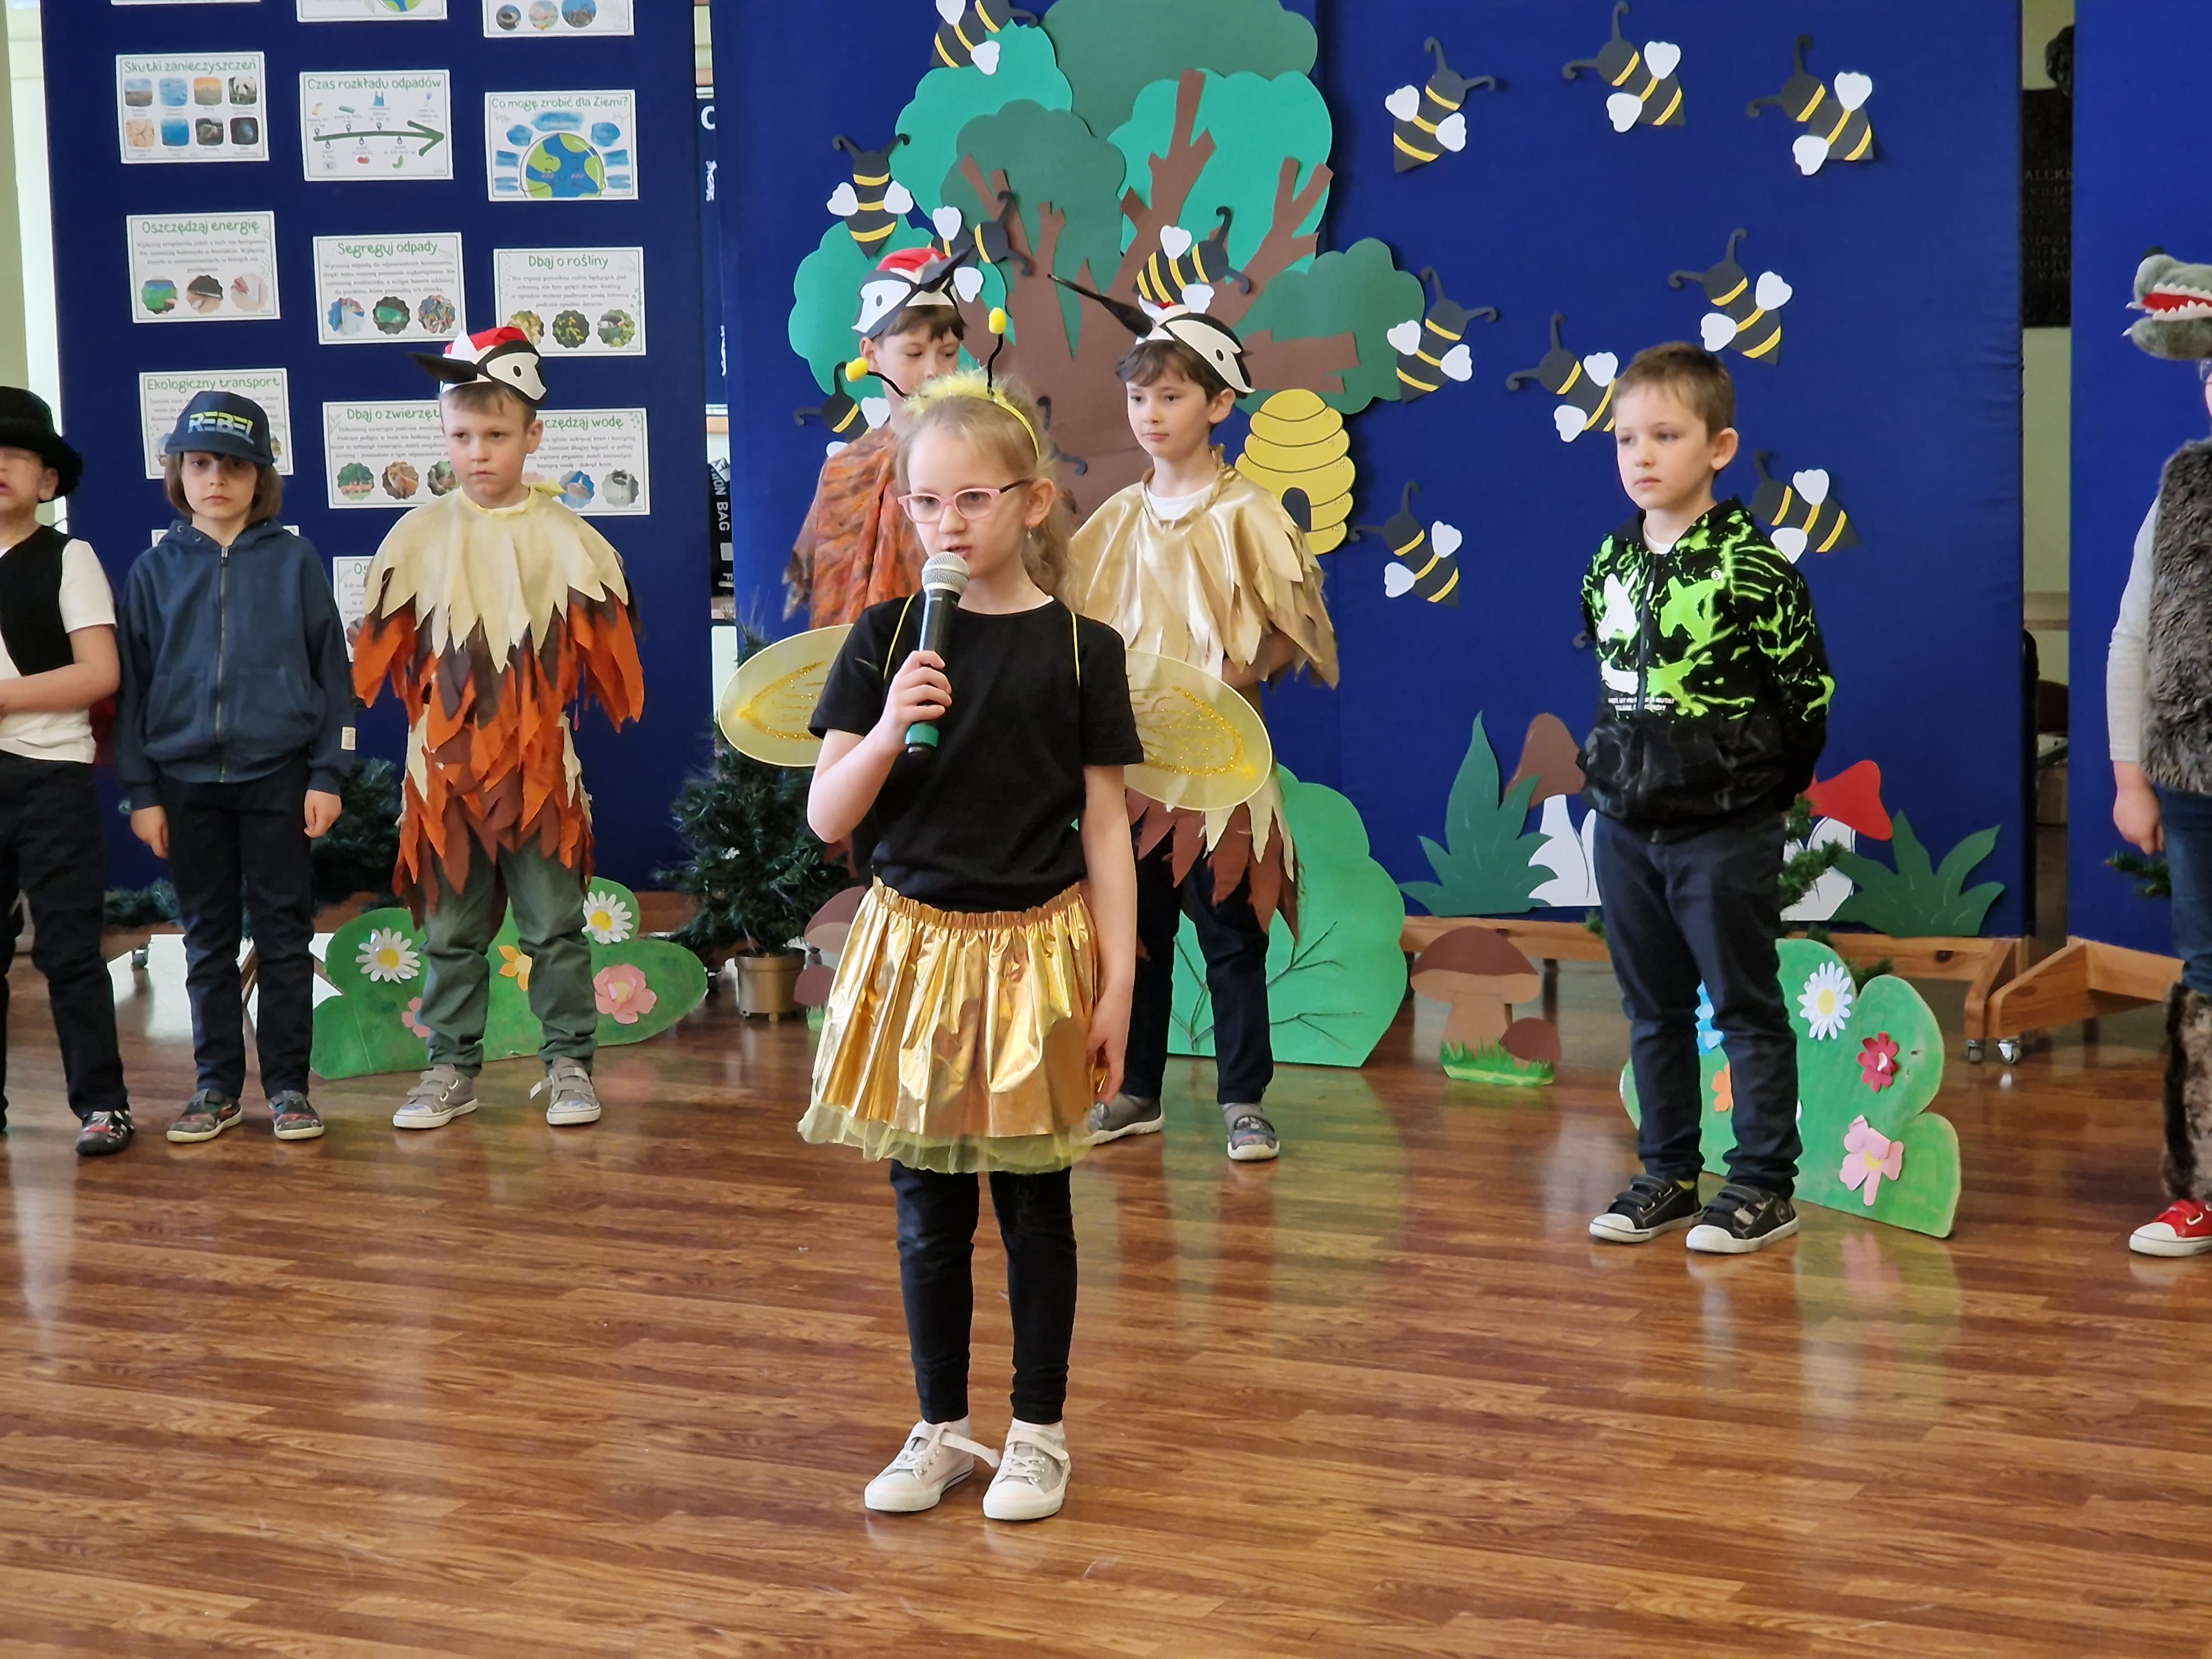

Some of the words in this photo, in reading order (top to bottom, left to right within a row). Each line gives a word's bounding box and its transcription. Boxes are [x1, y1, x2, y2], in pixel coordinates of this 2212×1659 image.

[124, 61, 162, 73] Skutki
[166, 58, 257, 75] zanieczyszczeń
[307, 78, 335, 90] Czas
[338, 76, 389, 90] rozkładu
[392, 75, 441, 92] odpadów
[491, 98, 505, 108] Co
[508, 101, 538, 112] mogę
[541, 97, 572, 107] zrobić
[576, 96, 591, 107] dla
[593, 96, 628, 107] Ziemi?
[142, 220, 208, 236] Oszczędzaj
[211, 219, 259, 235] energię
[337, 241, 393, 258] Segreguj
[397, 239, 437, 255] odpady
[529, 255, 554, 270] Dbaj
[567, 253, 609, 270] rośliny
[147, 378, 216, 393] Ekologiczny
[219, 377, 280, 390] transport
[347, 408, 372, 423] Dbaj
[375, 410, 382, 419] o
[385, 408, 440, 421] zwierzęt
[545, 416, 589, 431] czędzaj
[591, 416, 624, 430] wodę
[187, 411, 254, 445] REBEL
[717, 502, 730, 531] BAG
